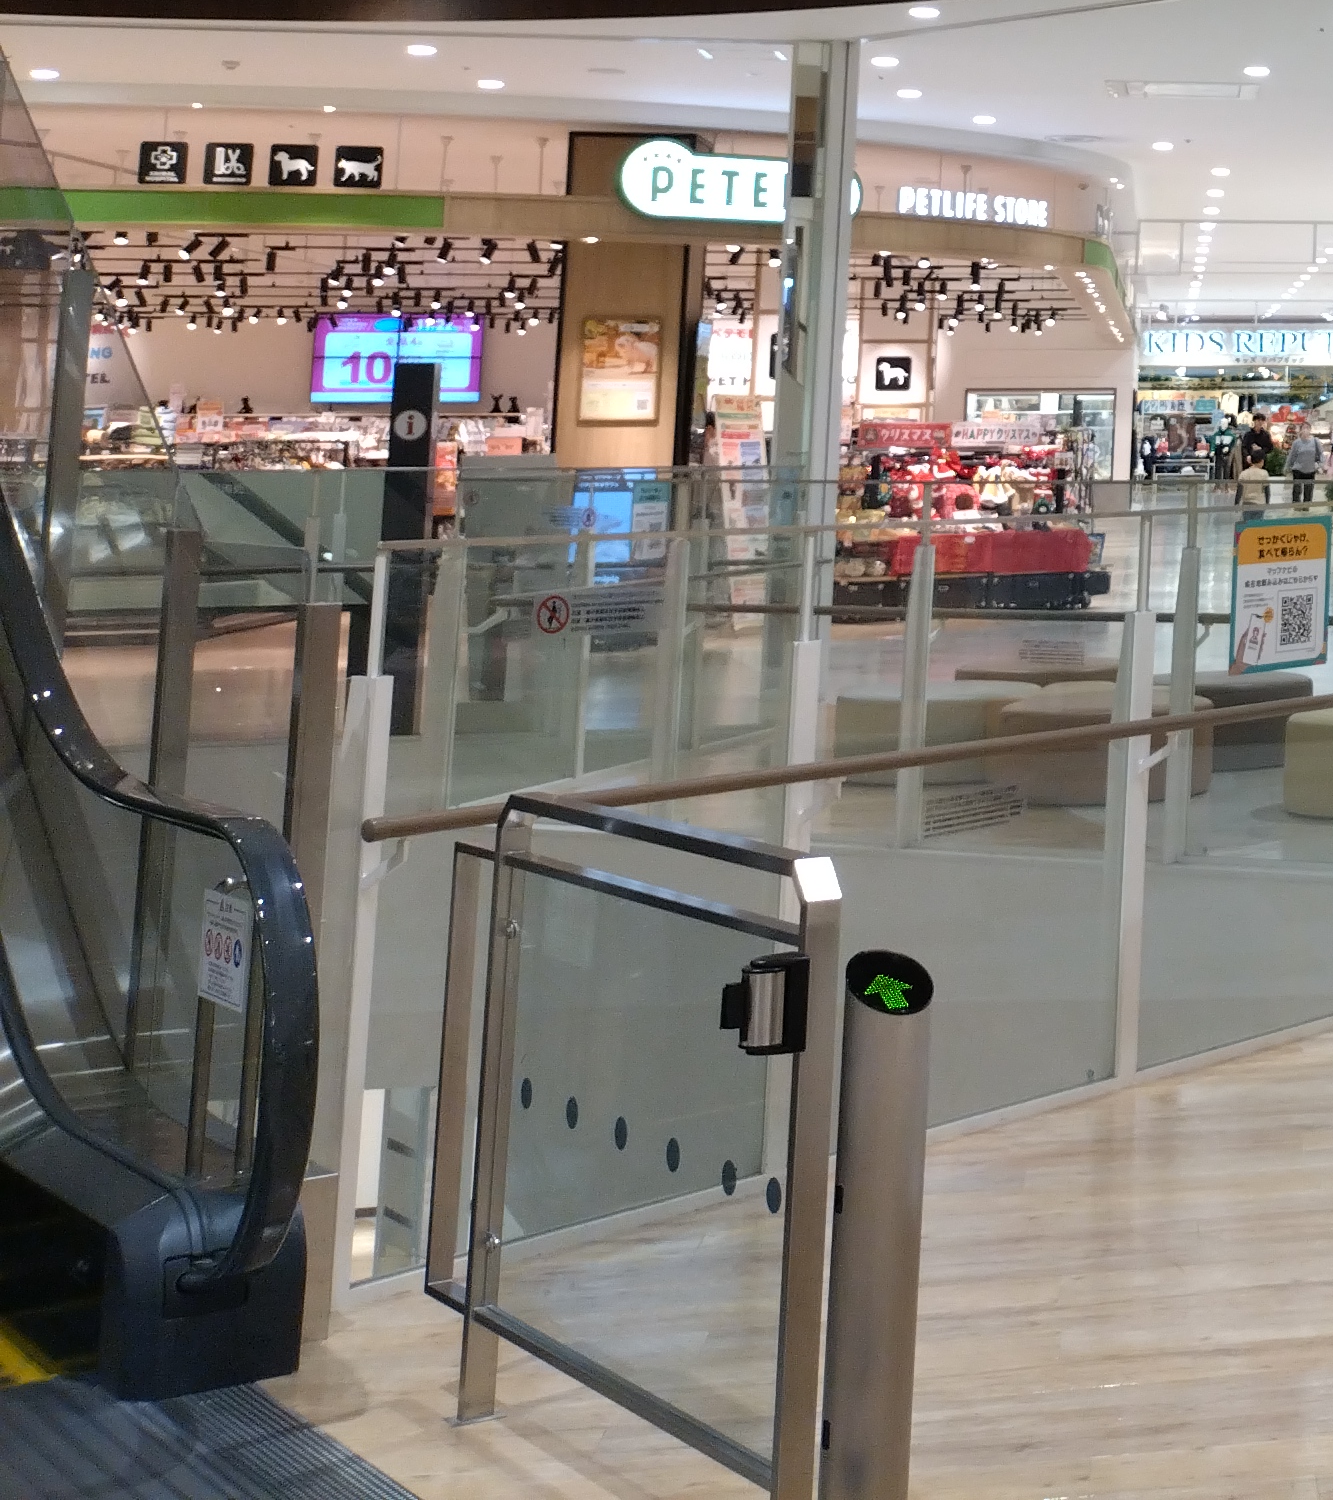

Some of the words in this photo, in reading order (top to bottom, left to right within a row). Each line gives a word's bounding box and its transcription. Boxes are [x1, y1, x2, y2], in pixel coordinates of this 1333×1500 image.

[650, 165, 788, 209] PETE
[898, 185, 989, 222] PETLIFE
[993, 194, 1049, 228] STORE
[1145, 330, 1225, 355] KIDS
[880, 428, 932, 442] クリスマス
[961, 427, 995, 440] HAPPY
